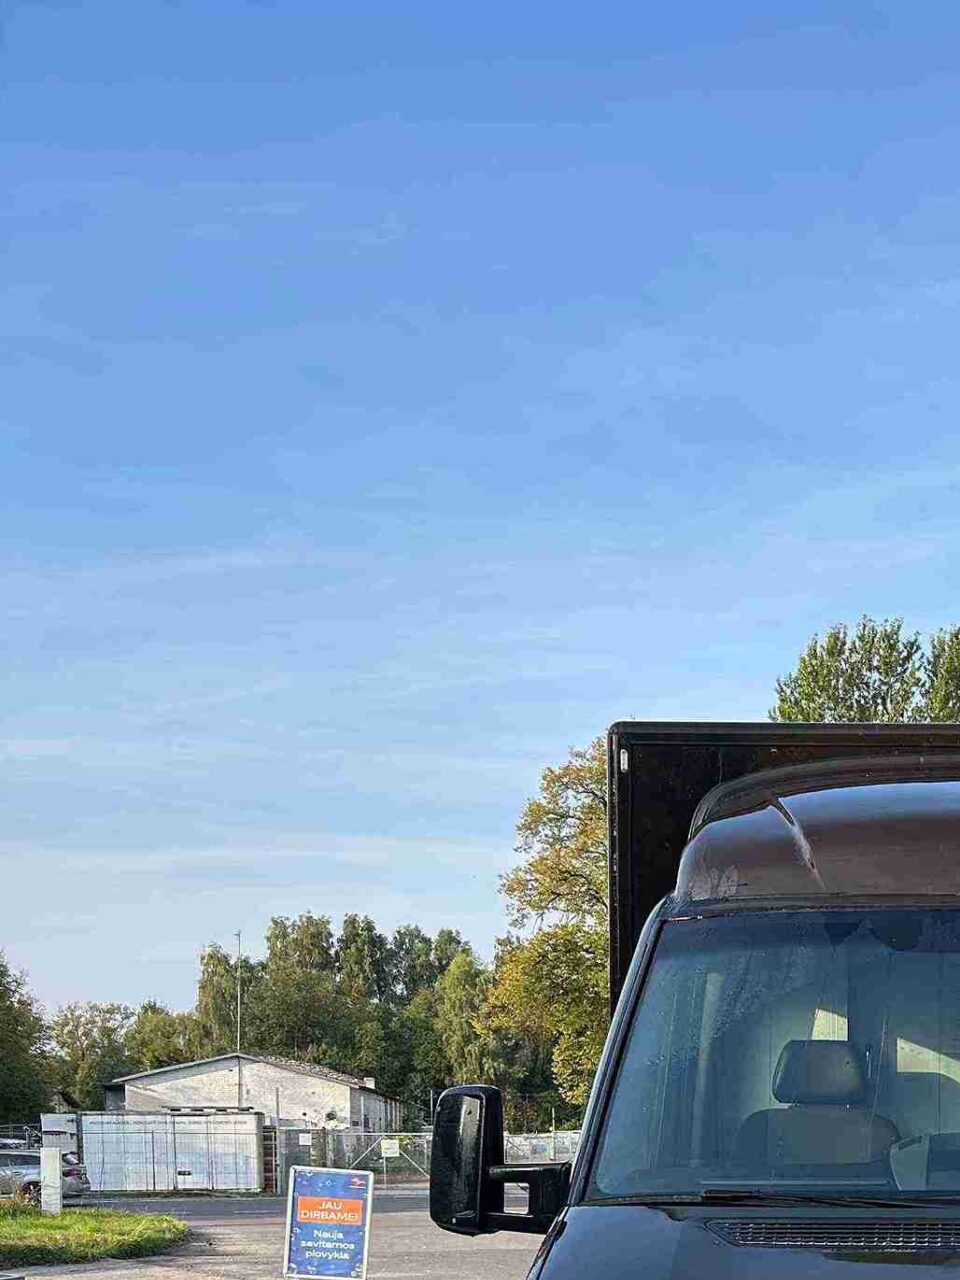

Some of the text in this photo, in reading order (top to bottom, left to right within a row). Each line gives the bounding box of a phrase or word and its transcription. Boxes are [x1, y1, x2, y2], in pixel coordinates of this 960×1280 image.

[318, 1200, 343, 1210] JAU
[313, 1229, 344, 1240] Nauja
[305, 1249, 350, 1260] plovykla
